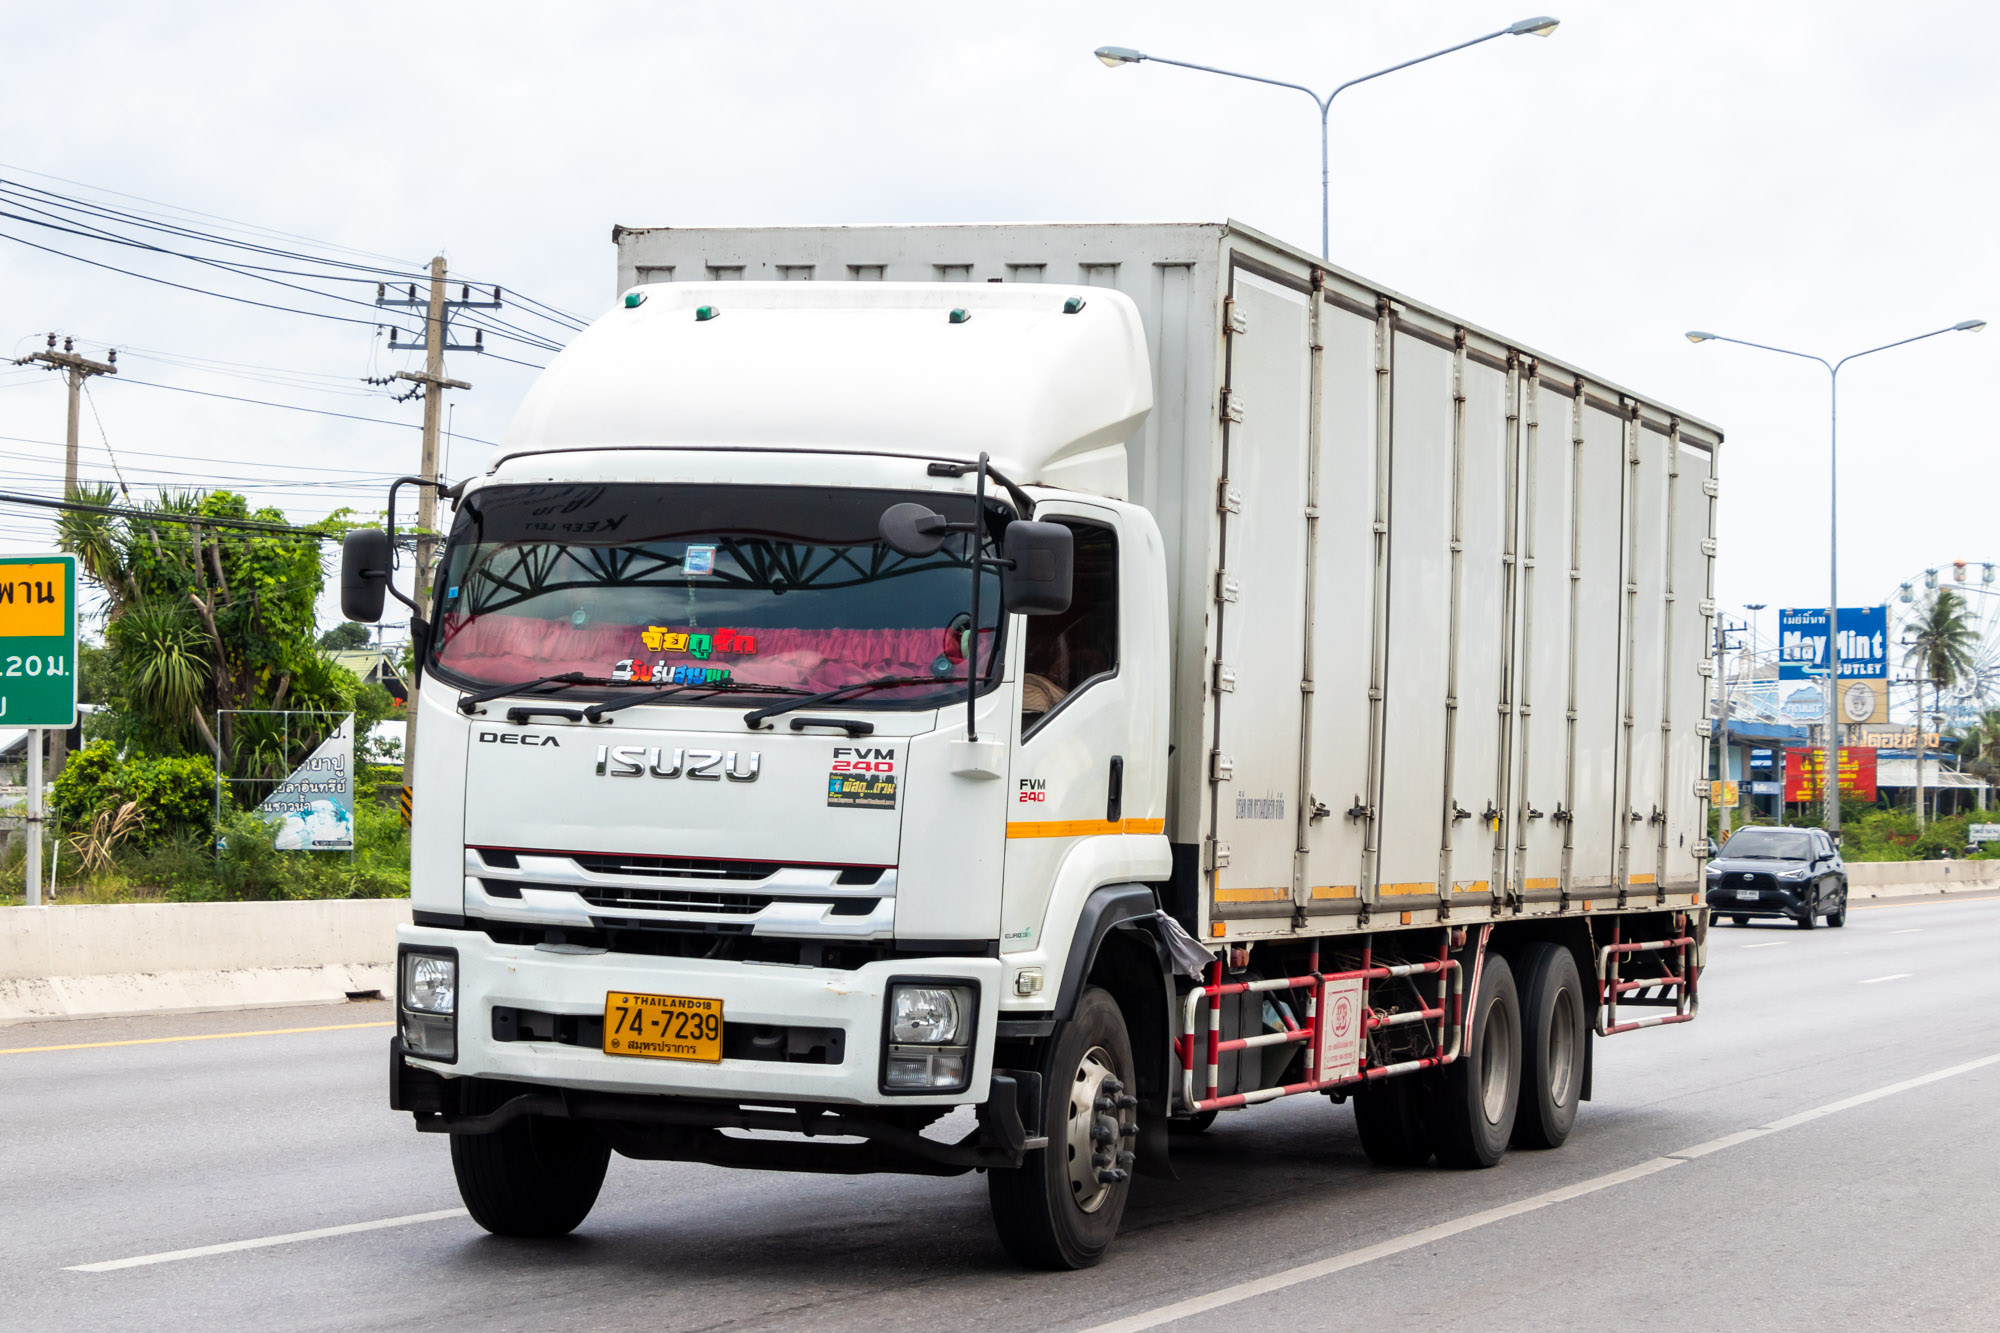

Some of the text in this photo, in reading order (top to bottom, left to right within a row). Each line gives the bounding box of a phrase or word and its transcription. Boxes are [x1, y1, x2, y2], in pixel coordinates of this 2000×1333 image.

[1783, 631, 1827, 664] May
[479, 732, 560, 747] DECA
[833, 747, 894, 760] FVM
[595, 744, 761, 783] ISUZU
[832, 760, 894, 772] 240
[1019, 778, 1046, 790] FVM
[1019, 791, 1046, 803] 240
[633, 996, 694, 1010] THAILAND
[614, 1006, 719, 1041] 74-7239
[627, 1040, 697, 1055] สมุทรปราการ
